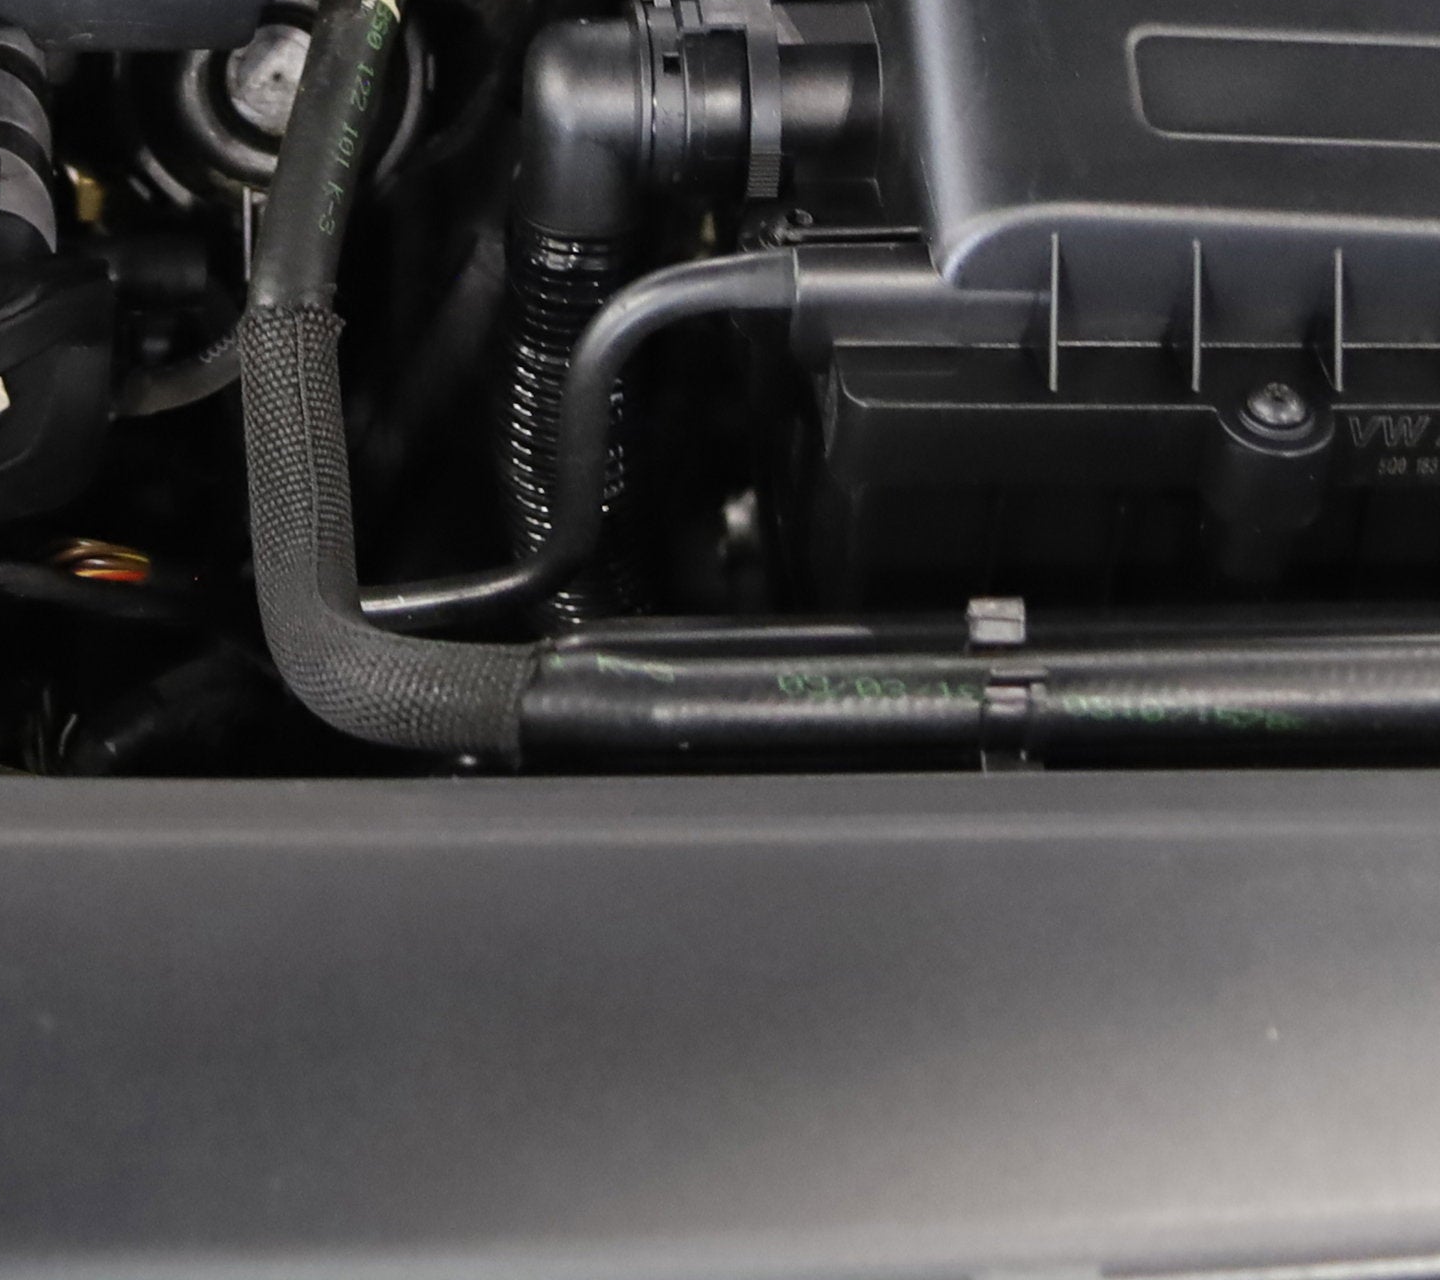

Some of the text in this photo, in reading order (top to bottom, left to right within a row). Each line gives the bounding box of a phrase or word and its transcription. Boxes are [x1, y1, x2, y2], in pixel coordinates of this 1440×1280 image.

[335, 121, 360, 170] 101
[318, 180, 345, 236] K-3
[1347, 414, 1432, 448] VW
